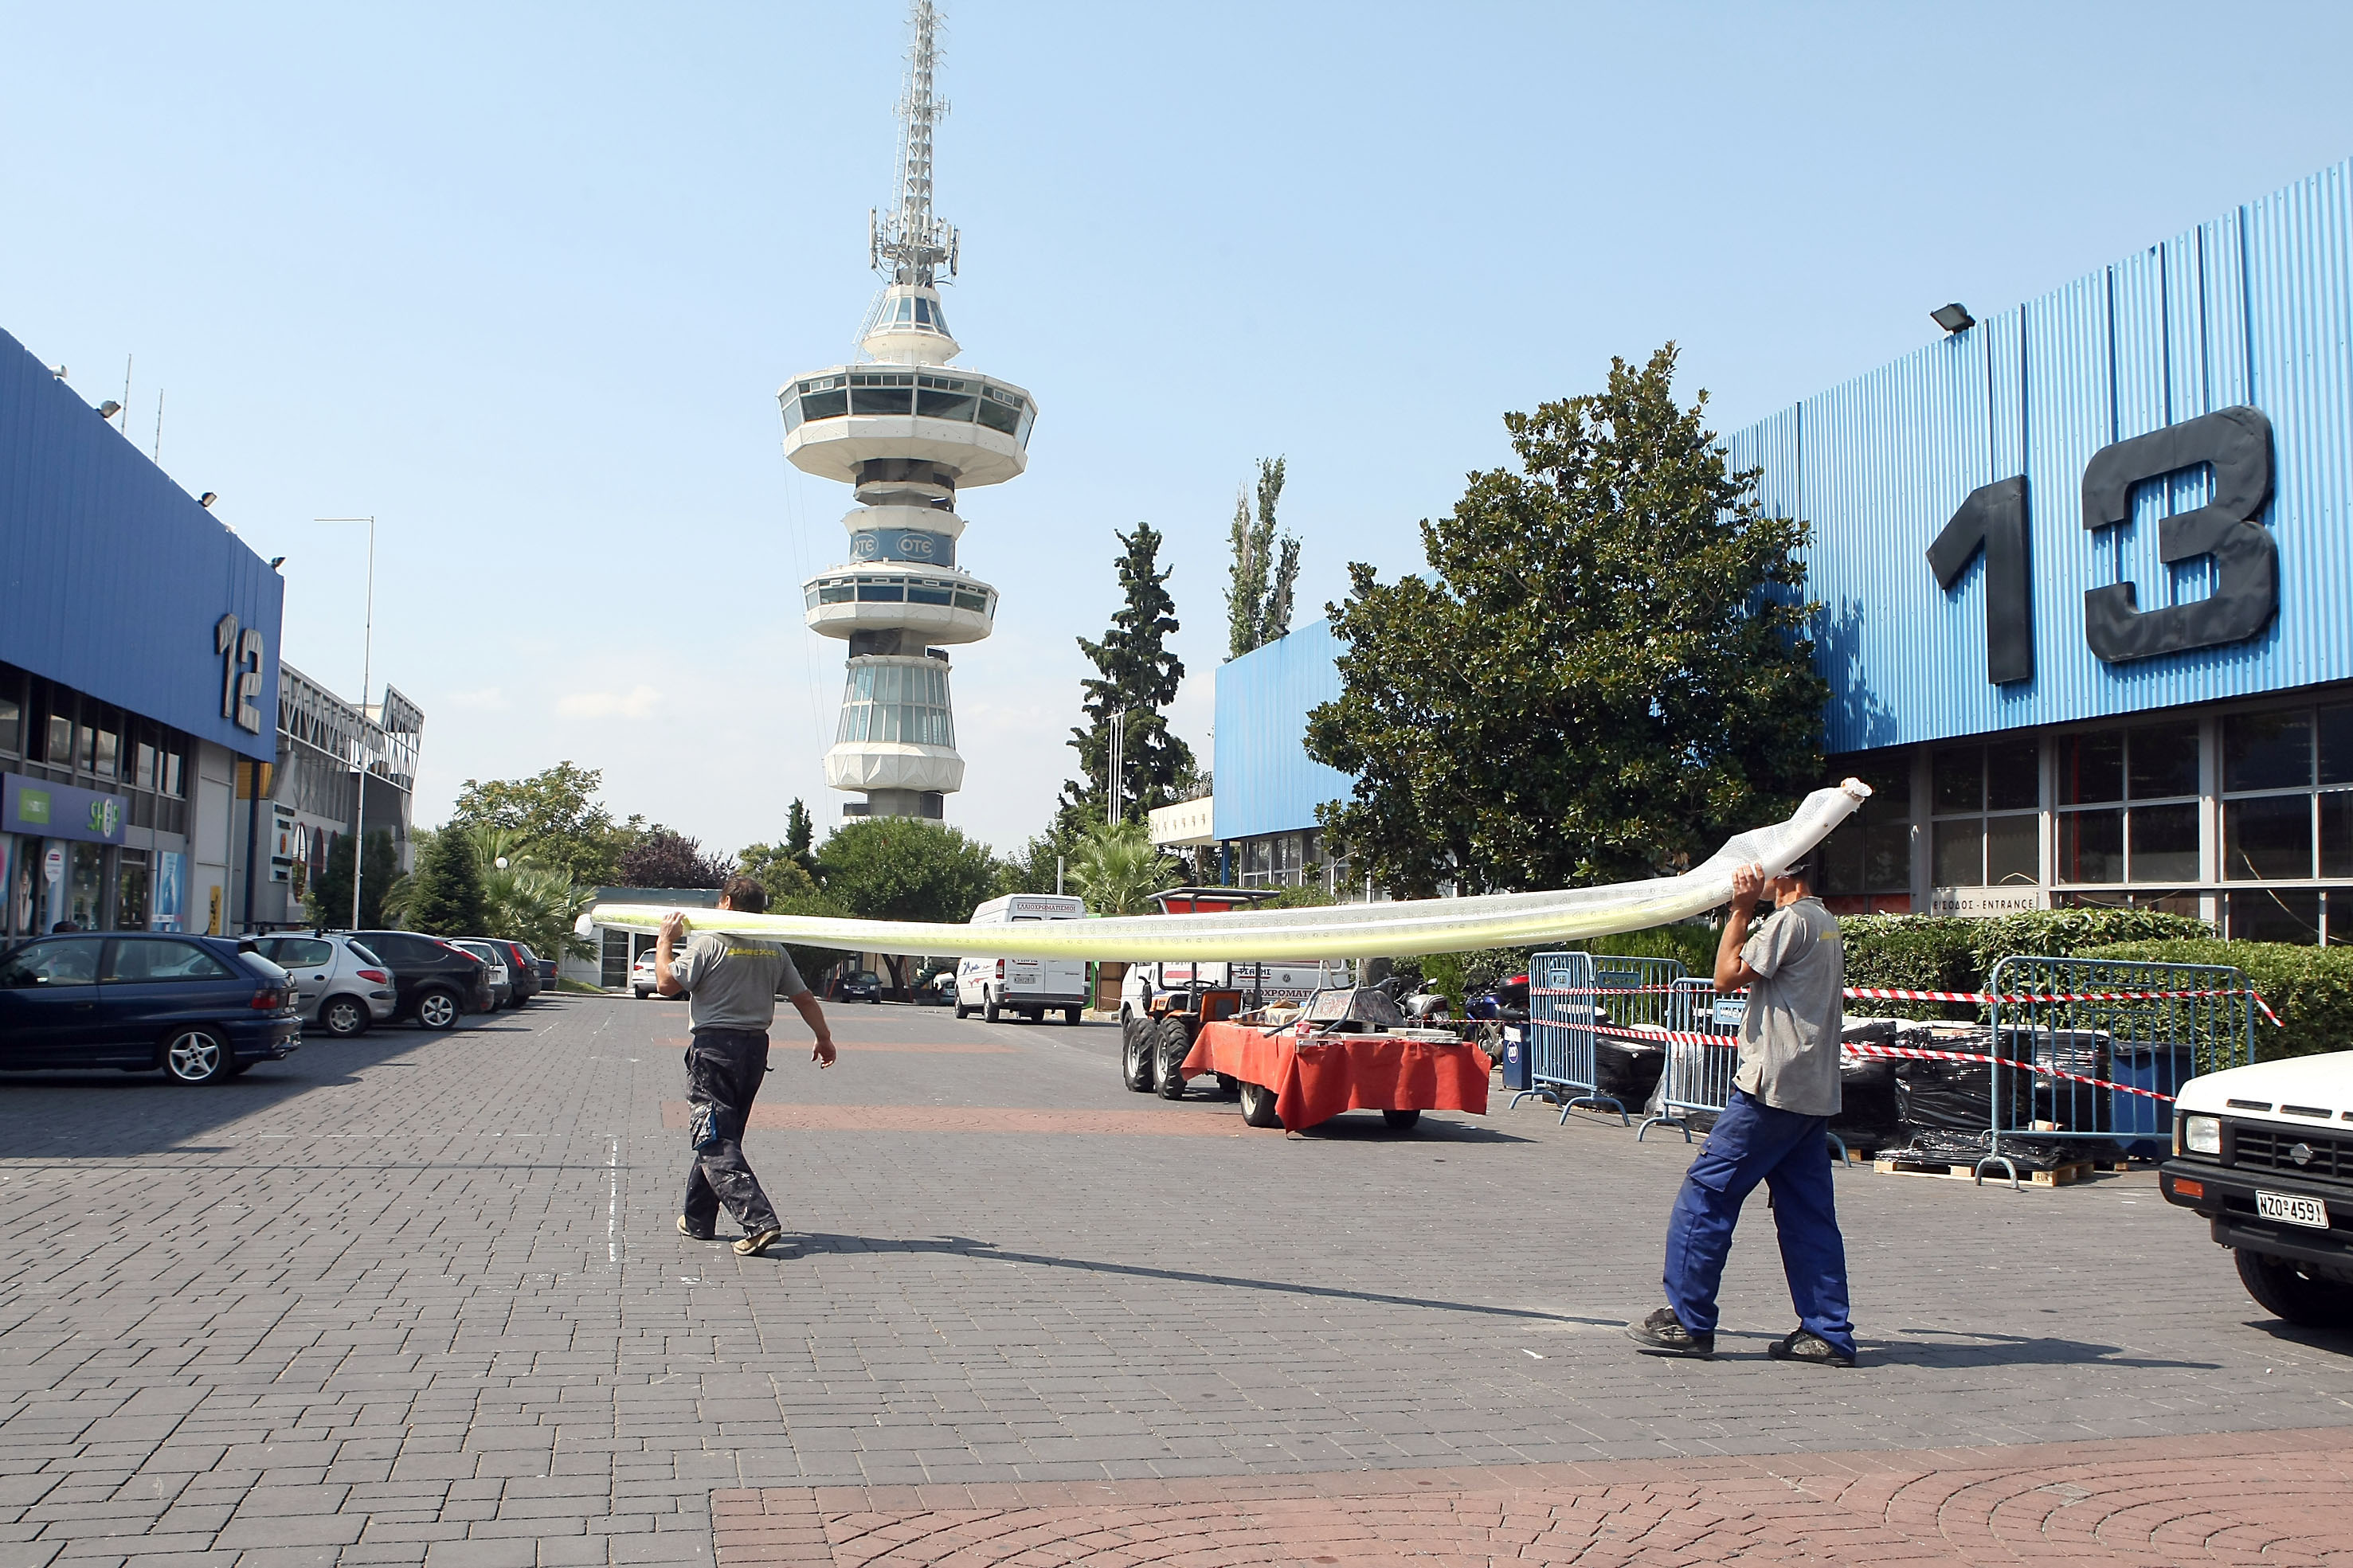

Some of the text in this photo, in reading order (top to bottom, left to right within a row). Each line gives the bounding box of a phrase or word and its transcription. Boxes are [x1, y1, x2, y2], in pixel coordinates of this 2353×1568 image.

[900, 538, 932, 553] OTE
[1924, 405, 2281, 686] 13
[216, 613, 264, 735] 12
[87, 799, 121, 838] SHOP
[1933, 900, 1974, 909] ΕΙΣΟΔΟΣ
[1982, 899, 2034, 909] ENTRANCE
[2037, 1172, 2050, 1182] EUR
